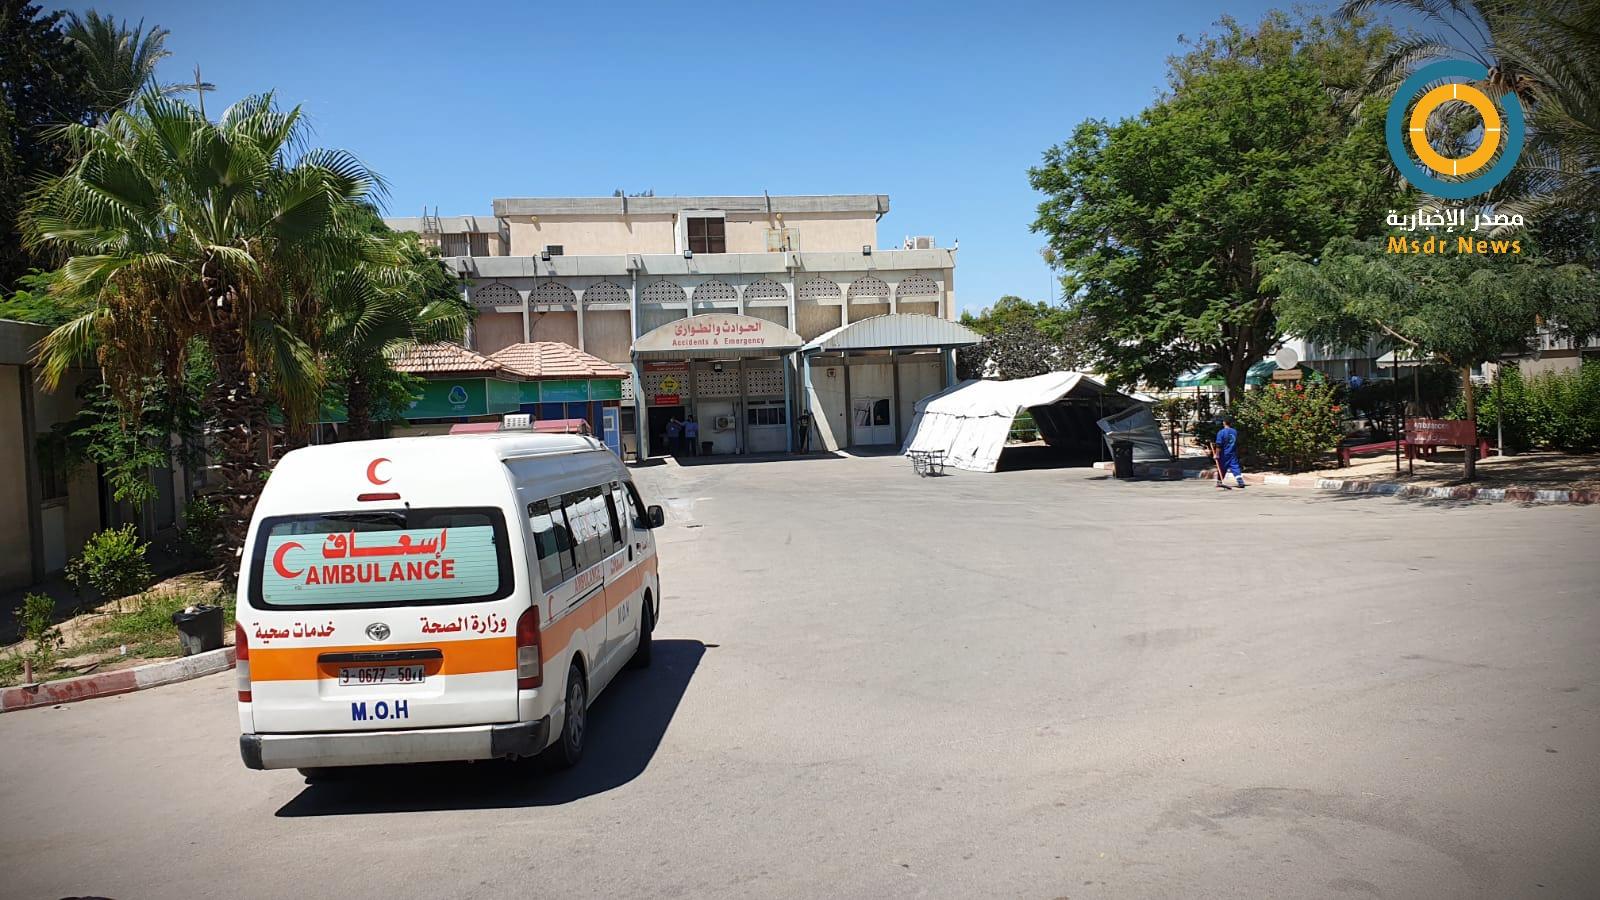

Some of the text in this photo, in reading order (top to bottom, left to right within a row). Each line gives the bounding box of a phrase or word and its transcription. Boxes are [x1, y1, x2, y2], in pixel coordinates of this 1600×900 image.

[722, 320, 762, 335] الحوادث
[672, 338, 709, 346] Accidents
[724, 337, 765, 345] Emergency
[322, 527, 447, 559] إسعاف
[305, 559, 456, 585] AMBULANCE
[253, 621, 336, 644] خدمات صحية
[420, 613, 507, 634] وزارة الصحة
[351, 699, 409, 721] M.O.H
